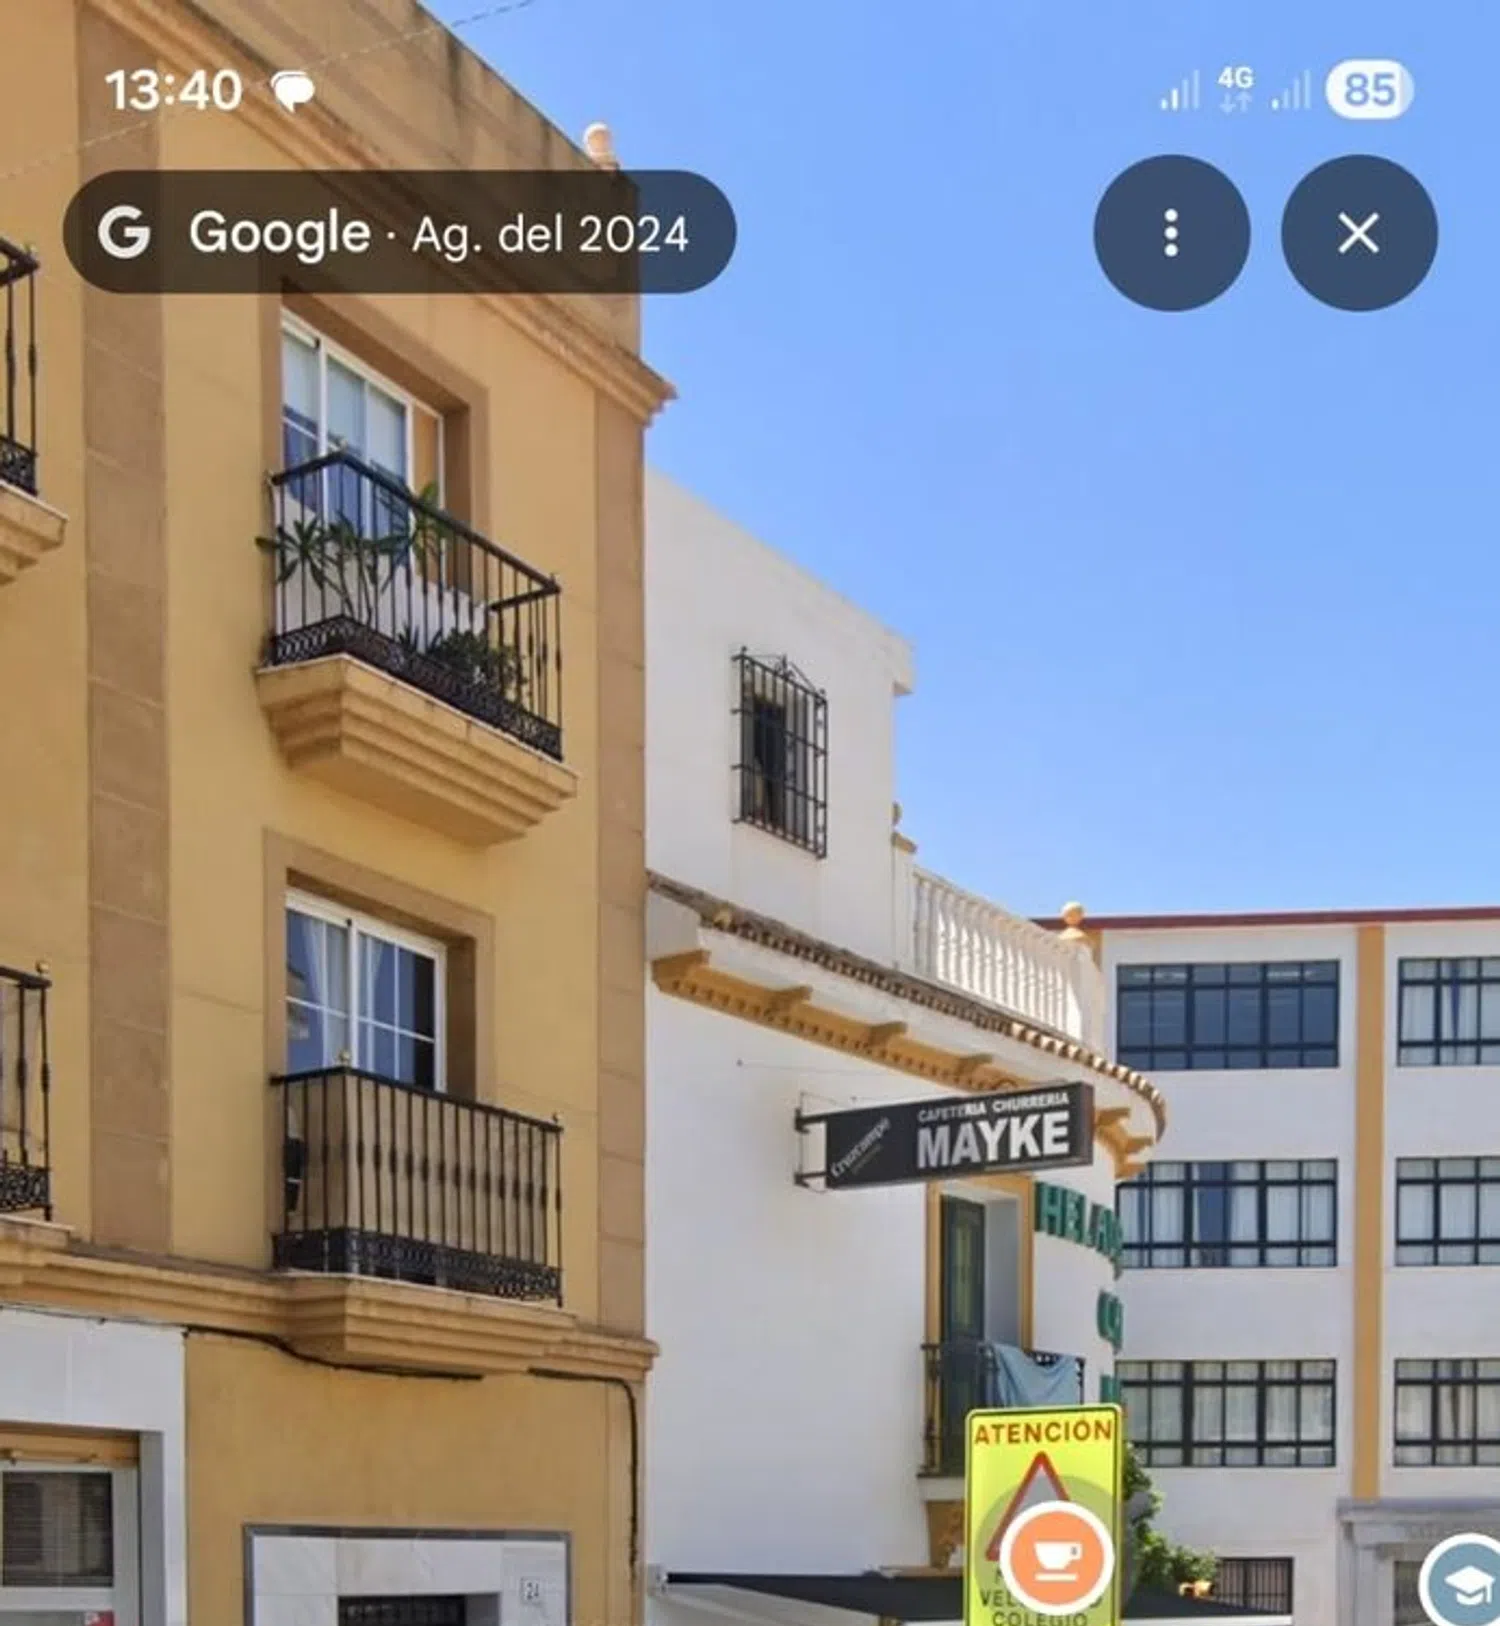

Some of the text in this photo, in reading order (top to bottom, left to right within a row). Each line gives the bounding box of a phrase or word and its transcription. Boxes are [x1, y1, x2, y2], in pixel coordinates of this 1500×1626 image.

[917, 1092, 1070, 1124] CAFETERIA CHURRERIA
[916, 1110, 1071, 1170] MAYKE
[974, 1416, 1112, 1446] ATENCIÓN
